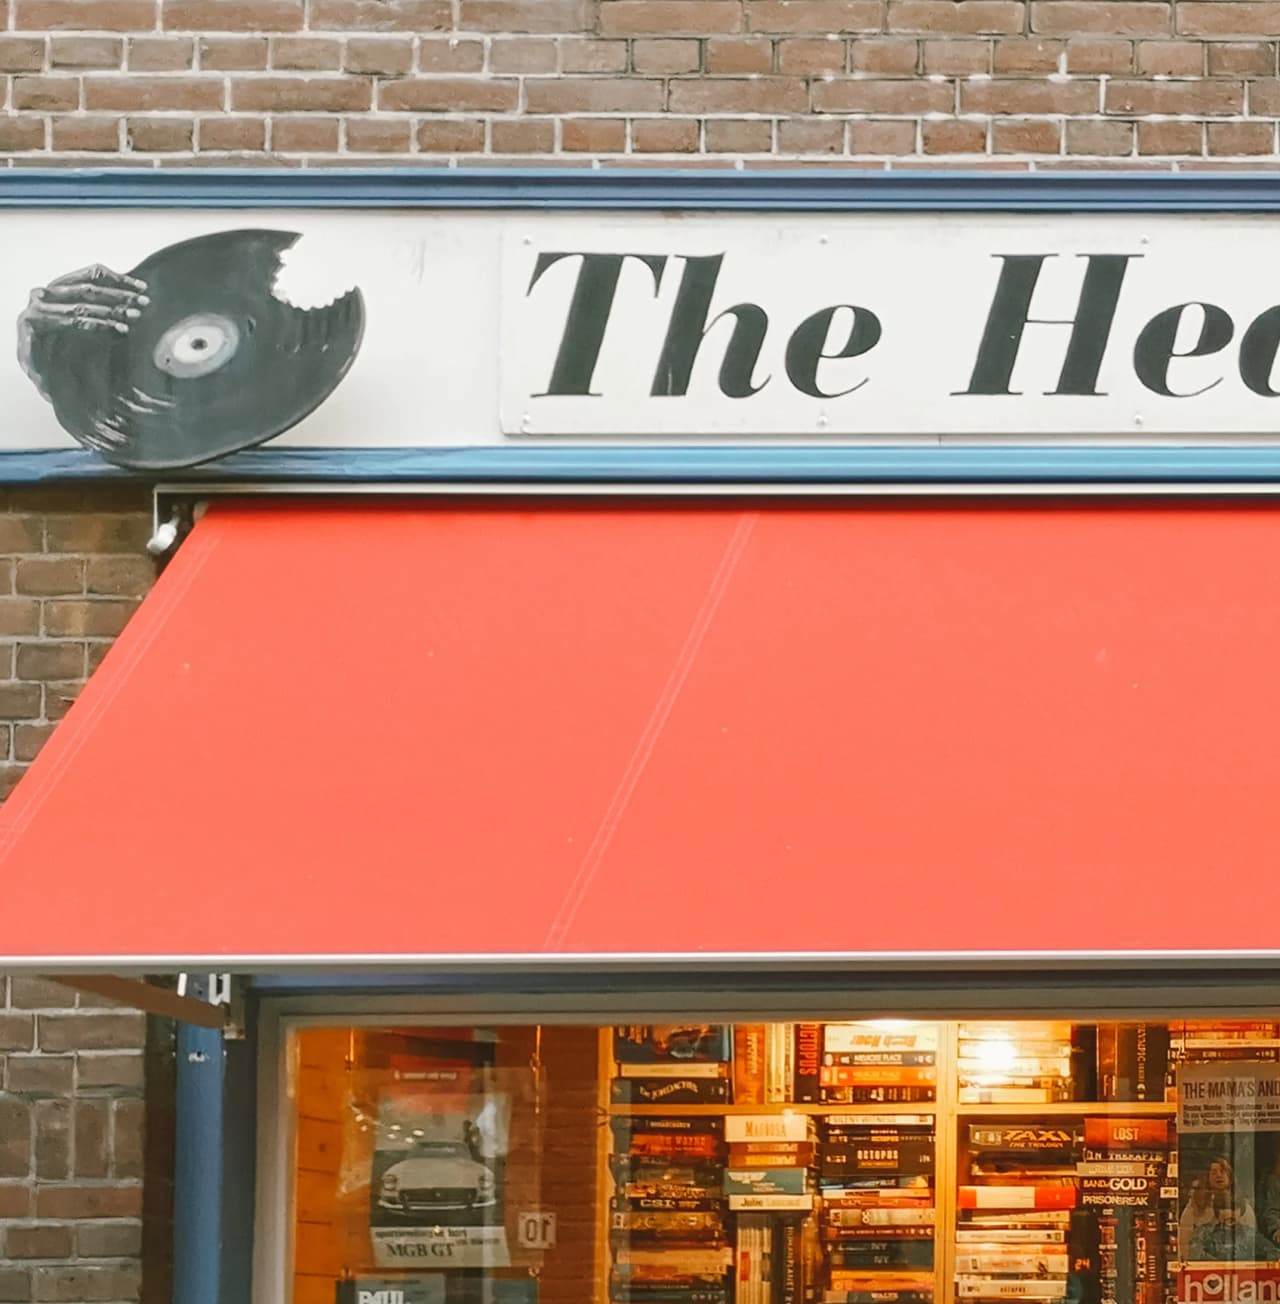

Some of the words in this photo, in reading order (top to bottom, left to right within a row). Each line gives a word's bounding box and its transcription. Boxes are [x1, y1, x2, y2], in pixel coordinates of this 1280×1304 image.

[530, 254, 881, 398] The
[1183, 1083, 1205, 1099] THE
[1208, 1081, 1255, 1098] MAMA'S
[1002, 1130, 1071, 1141] TAXI
[1113, 1128, 1139, 1141] LOST
[1110, 1178, 1147, 1190] GOLD
